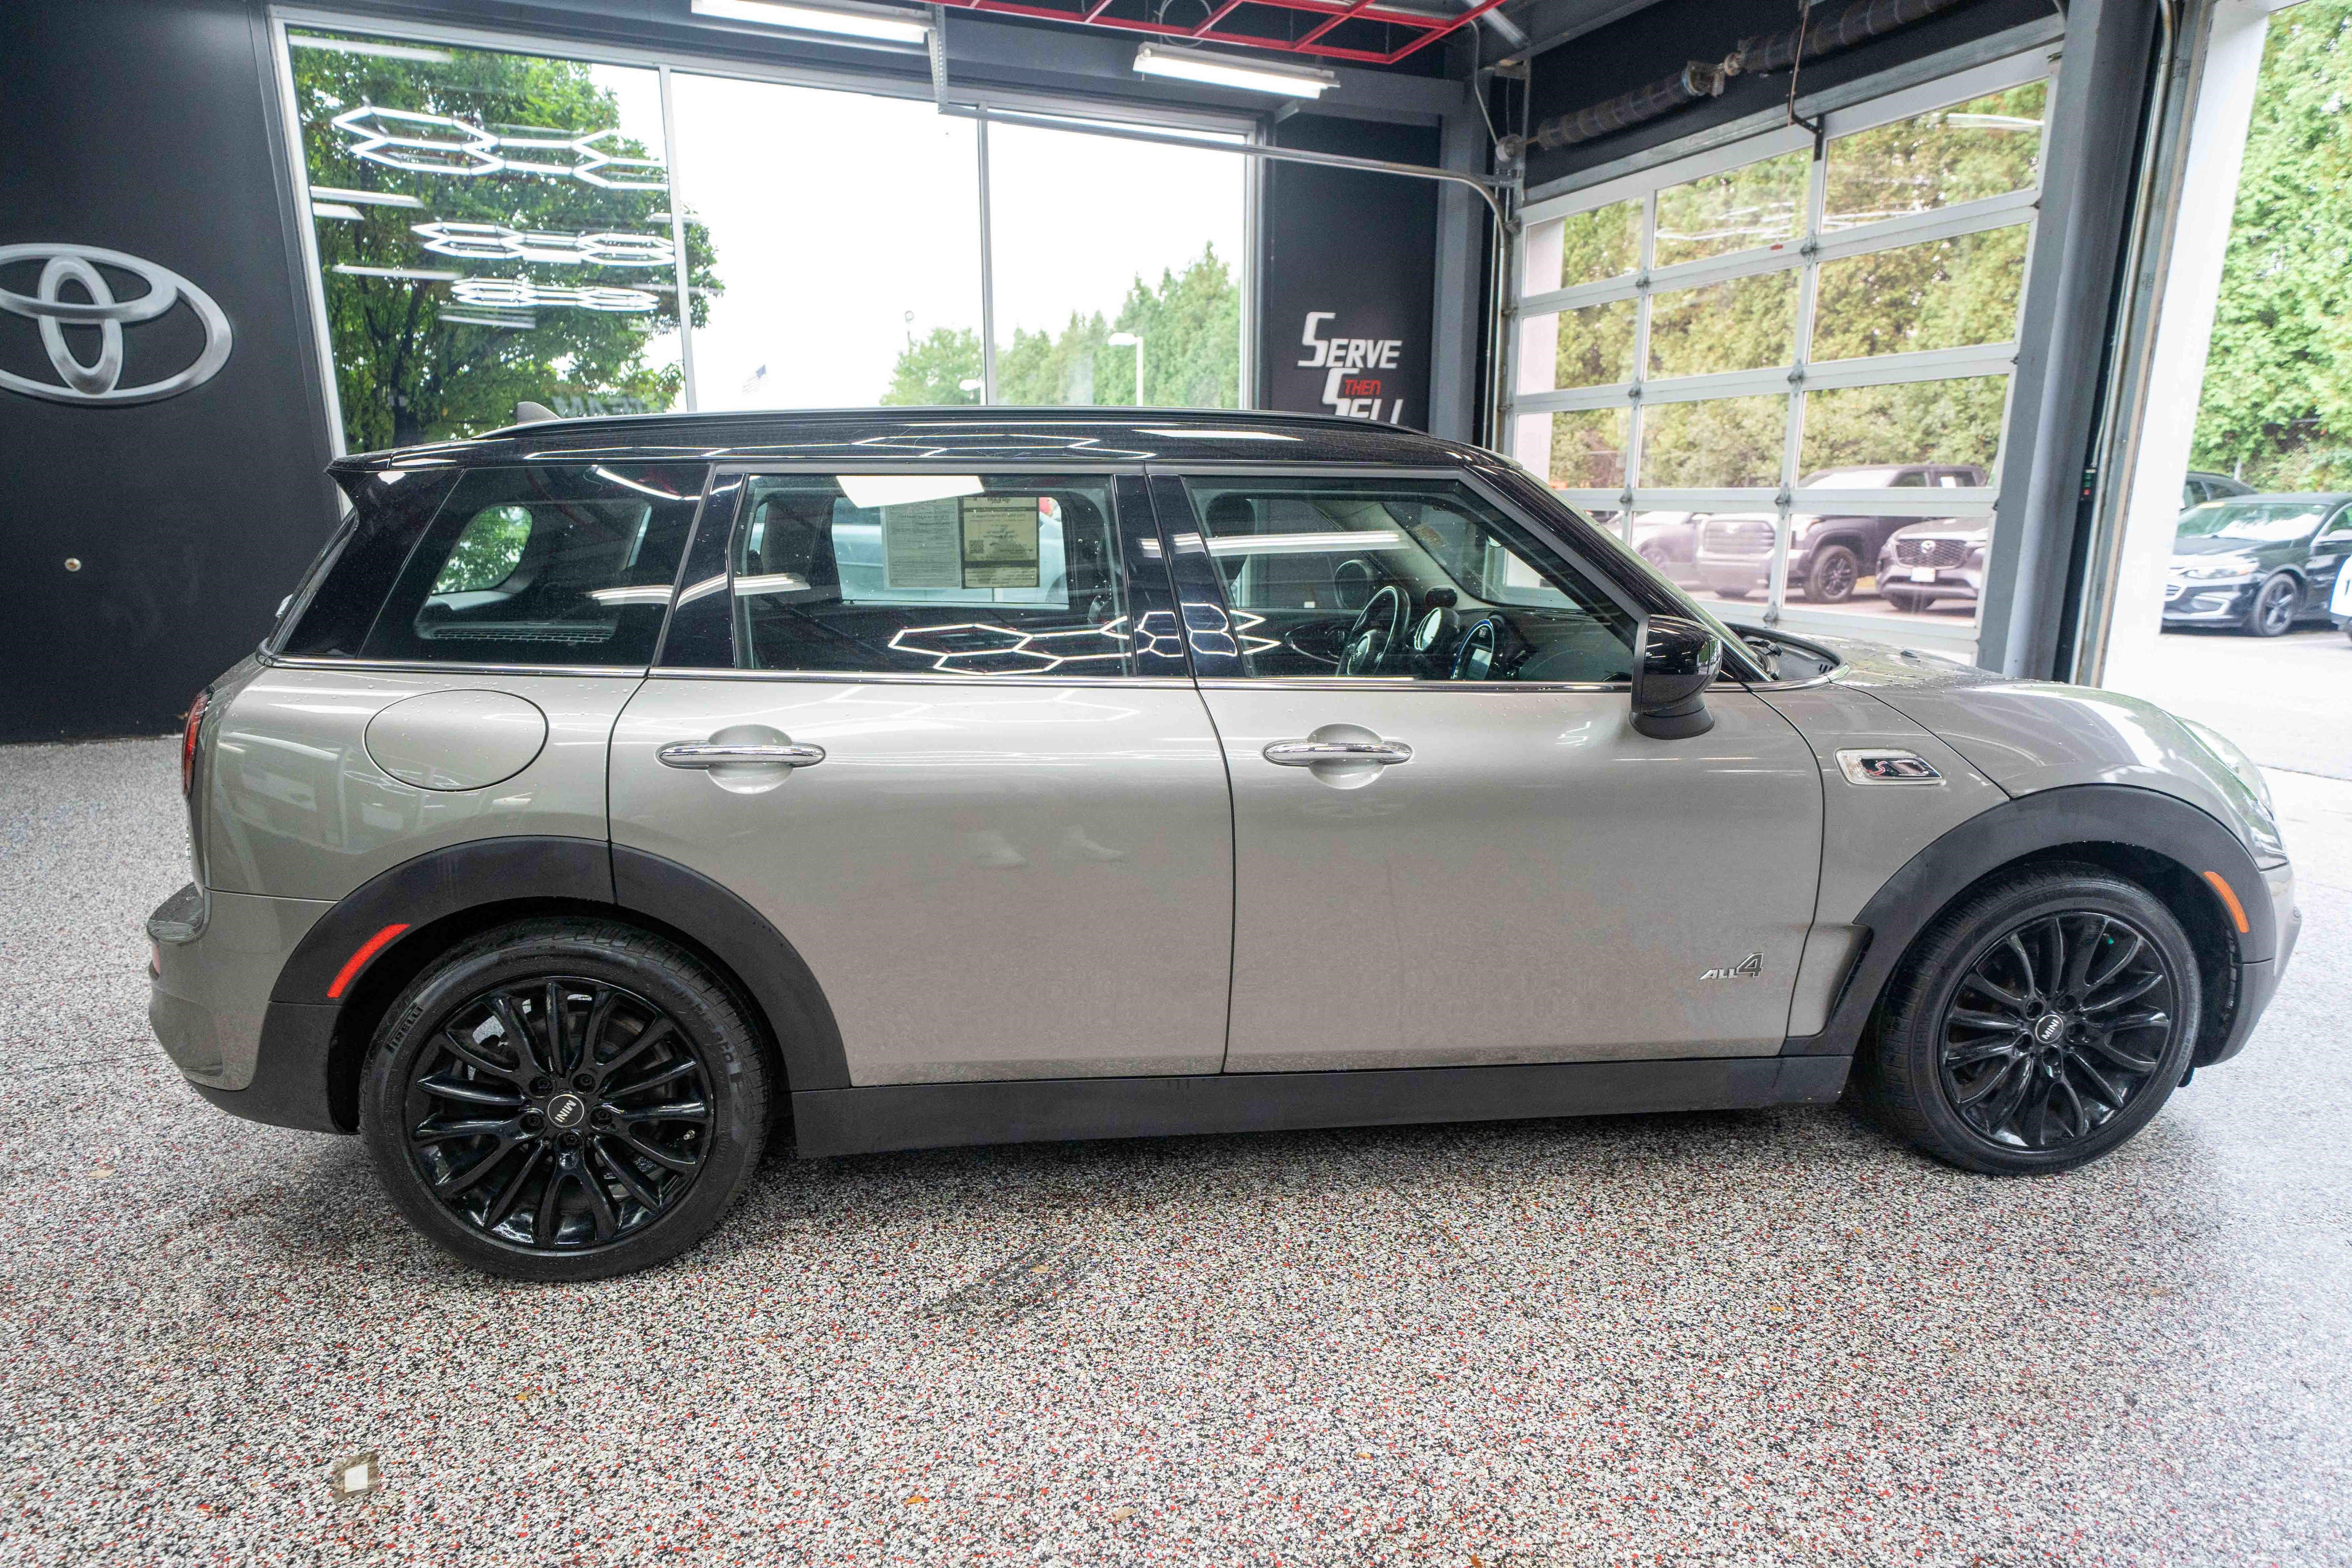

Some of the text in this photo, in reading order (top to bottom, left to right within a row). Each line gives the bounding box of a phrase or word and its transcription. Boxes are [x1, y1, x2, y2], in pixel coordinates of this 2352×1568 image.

[1297, 312, 1403, 368] SERVE
[1700, 952, 1764, 980] ALL4
[2041, 1019, 2059, 1040] MINI
[554, 1100, 577, 1123] MINI
